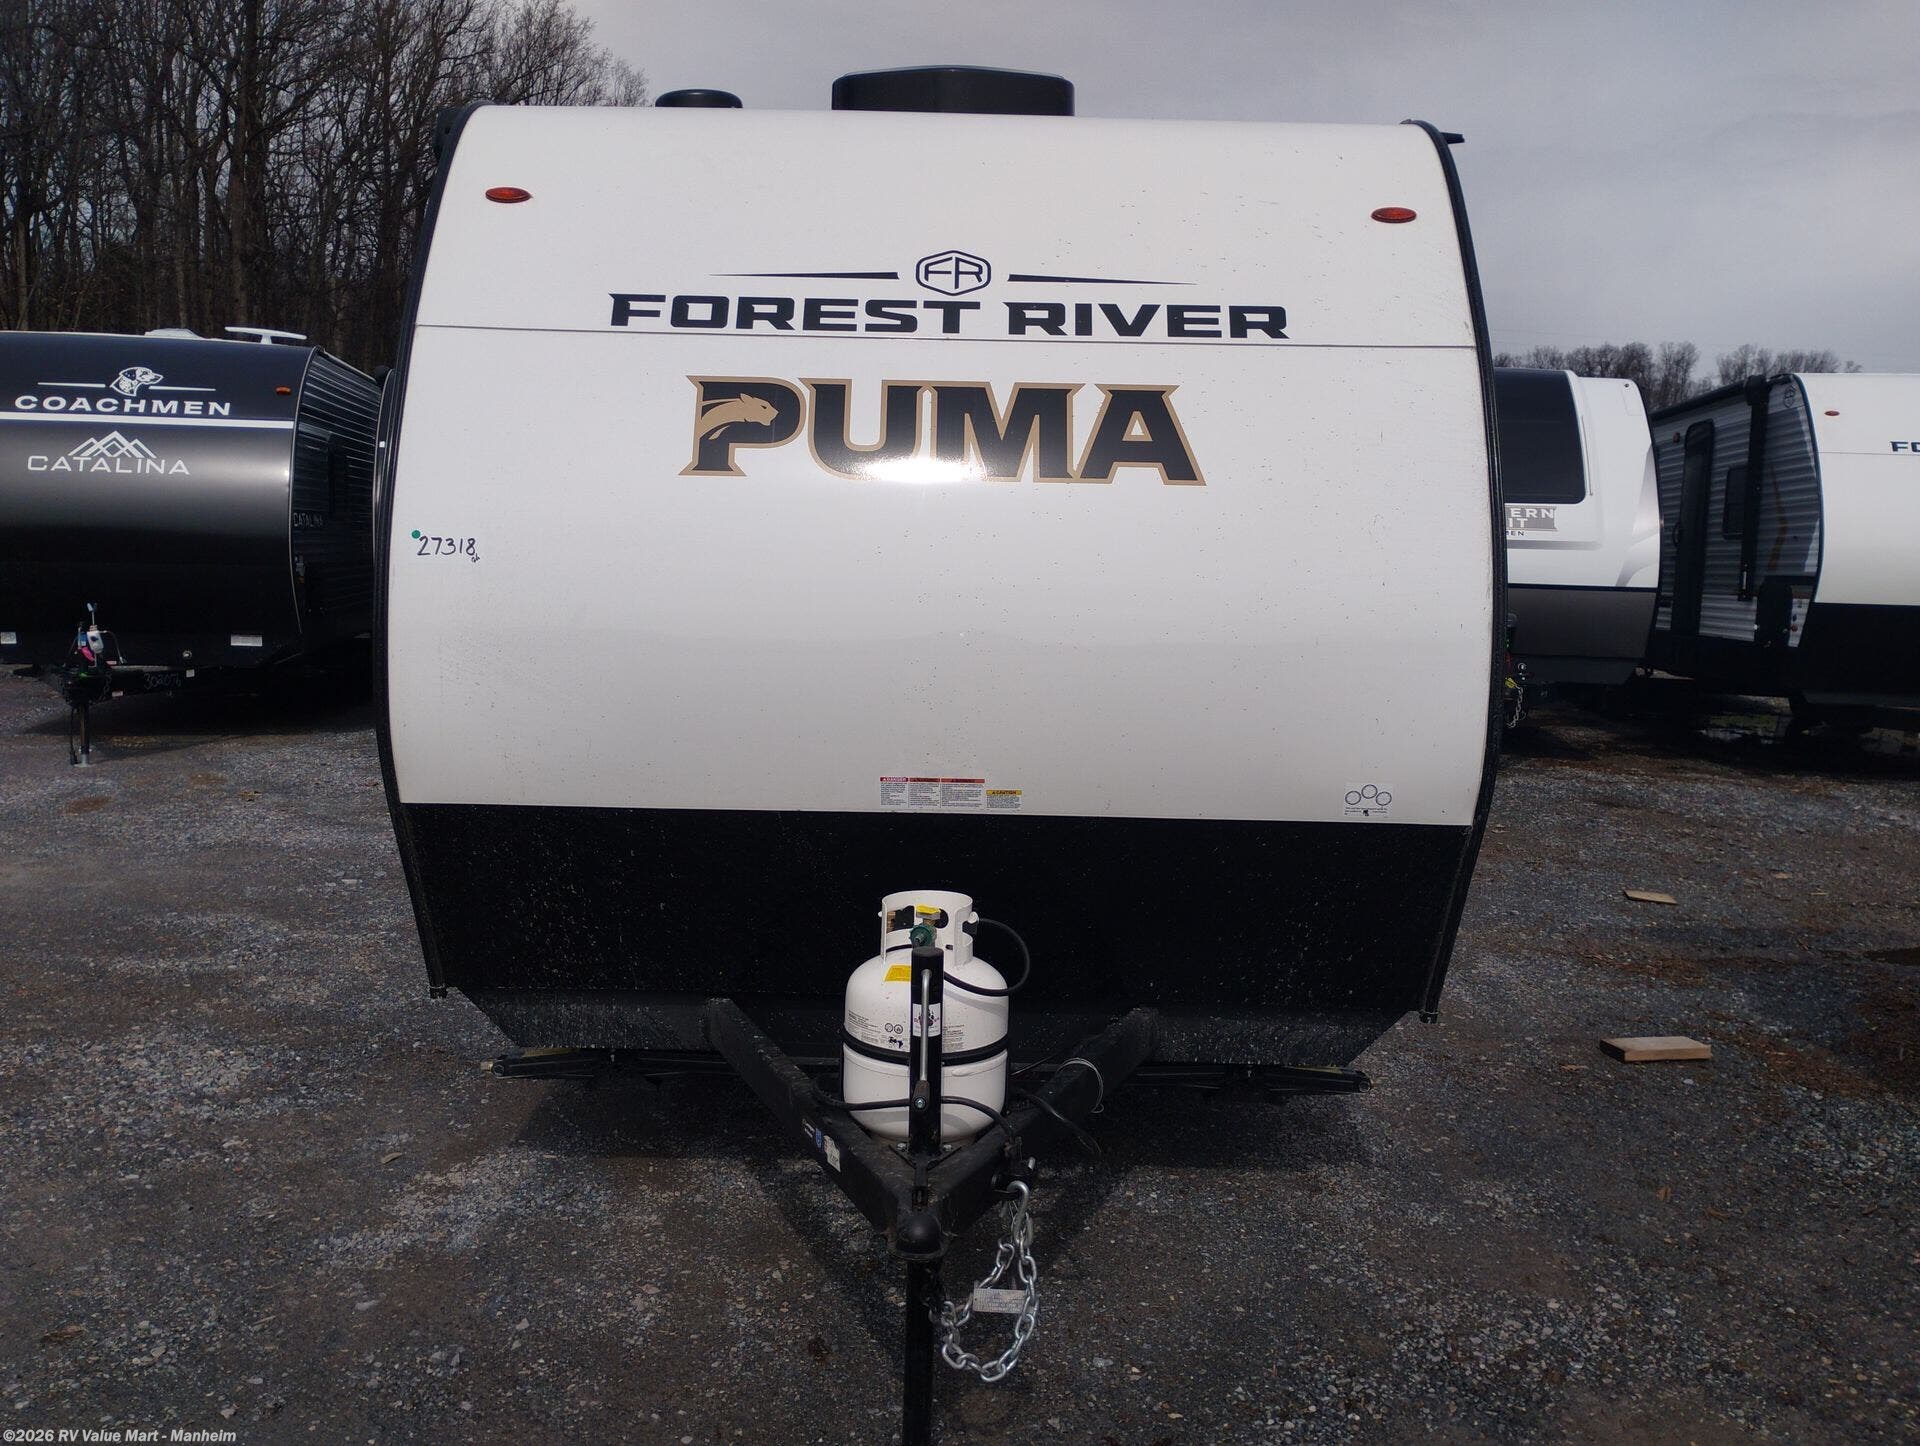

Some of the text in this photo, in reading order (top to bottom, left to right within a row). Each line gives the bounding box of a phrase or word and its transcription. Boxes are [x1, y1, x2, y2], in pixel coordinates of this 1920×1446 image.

[608, 292, 1290, 340] FOREST RIVER
[14, 394, 231, 416] COACHMEN
[677, 374, 1208, 487] PUMA
[27, 454, 191, 475] CATALINA
[417, 535, 476, 556] 27318
